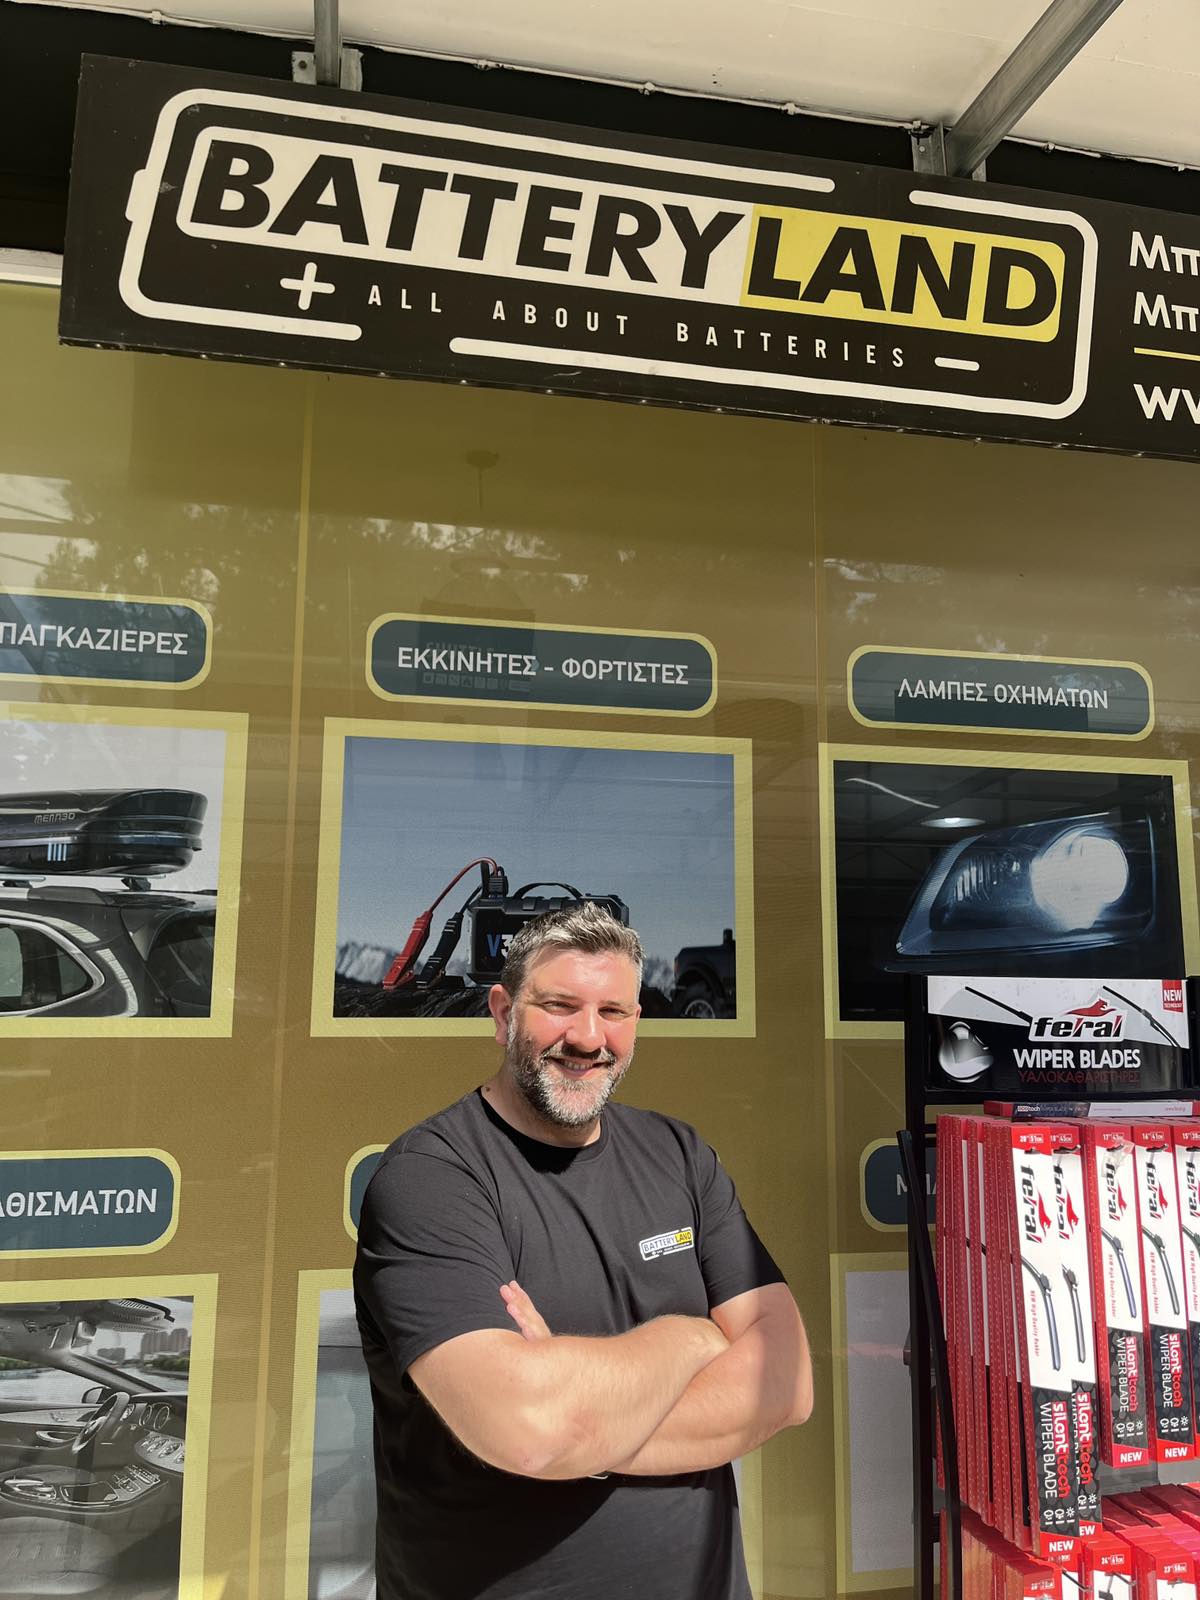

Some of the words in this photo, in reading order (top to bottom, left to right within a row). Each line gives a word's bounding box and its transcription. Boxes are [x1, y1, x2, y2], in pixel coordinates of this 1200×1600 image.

[189, 139, 1057, 326] BATTERYLAND
[368, 285, 442, 312] ALL
[492, 300, 629, 335] ABOUT
[677, 322, 904, 368] BATTERIES
[398, 647, 536, 676] ΕΚΚΙΝΗΤΕΣ
[562, 658, 689, 685] ΦΟΡΤΙΣΤΕΣ
[898, 678, 987, 703] ΛΑΜΠΕΣ
[994, 684, 1109, 709] ΟΧΗΜΑΤΩΝ
[1163, 989, 1182, 1001] NEW
[1034, 1015, 1122, 1038] feral
[1013, 1048, 1075, 1069] WIPER
[1080, 1048, 1141, 1069] BLADES
[1116, 1337, 1127, 1374] WIPER
[1159, 1334, 1170, 1371] WIPER
[1118, 1376, 1129, 1413] BLADE
[1161, 1373, 1173, 1408] BLADE
[1040, 1402, 1054, 1451] WIPER
[1120, 1452, 1142, 1463] NEW
[1165, 1447, 1188, 1458] NEW
[1043, 1453, 1058, 1499] BLADE
[1049, 1540, 1074, 1552] NEW
[1079, 1525, 1095, 1536] EW
